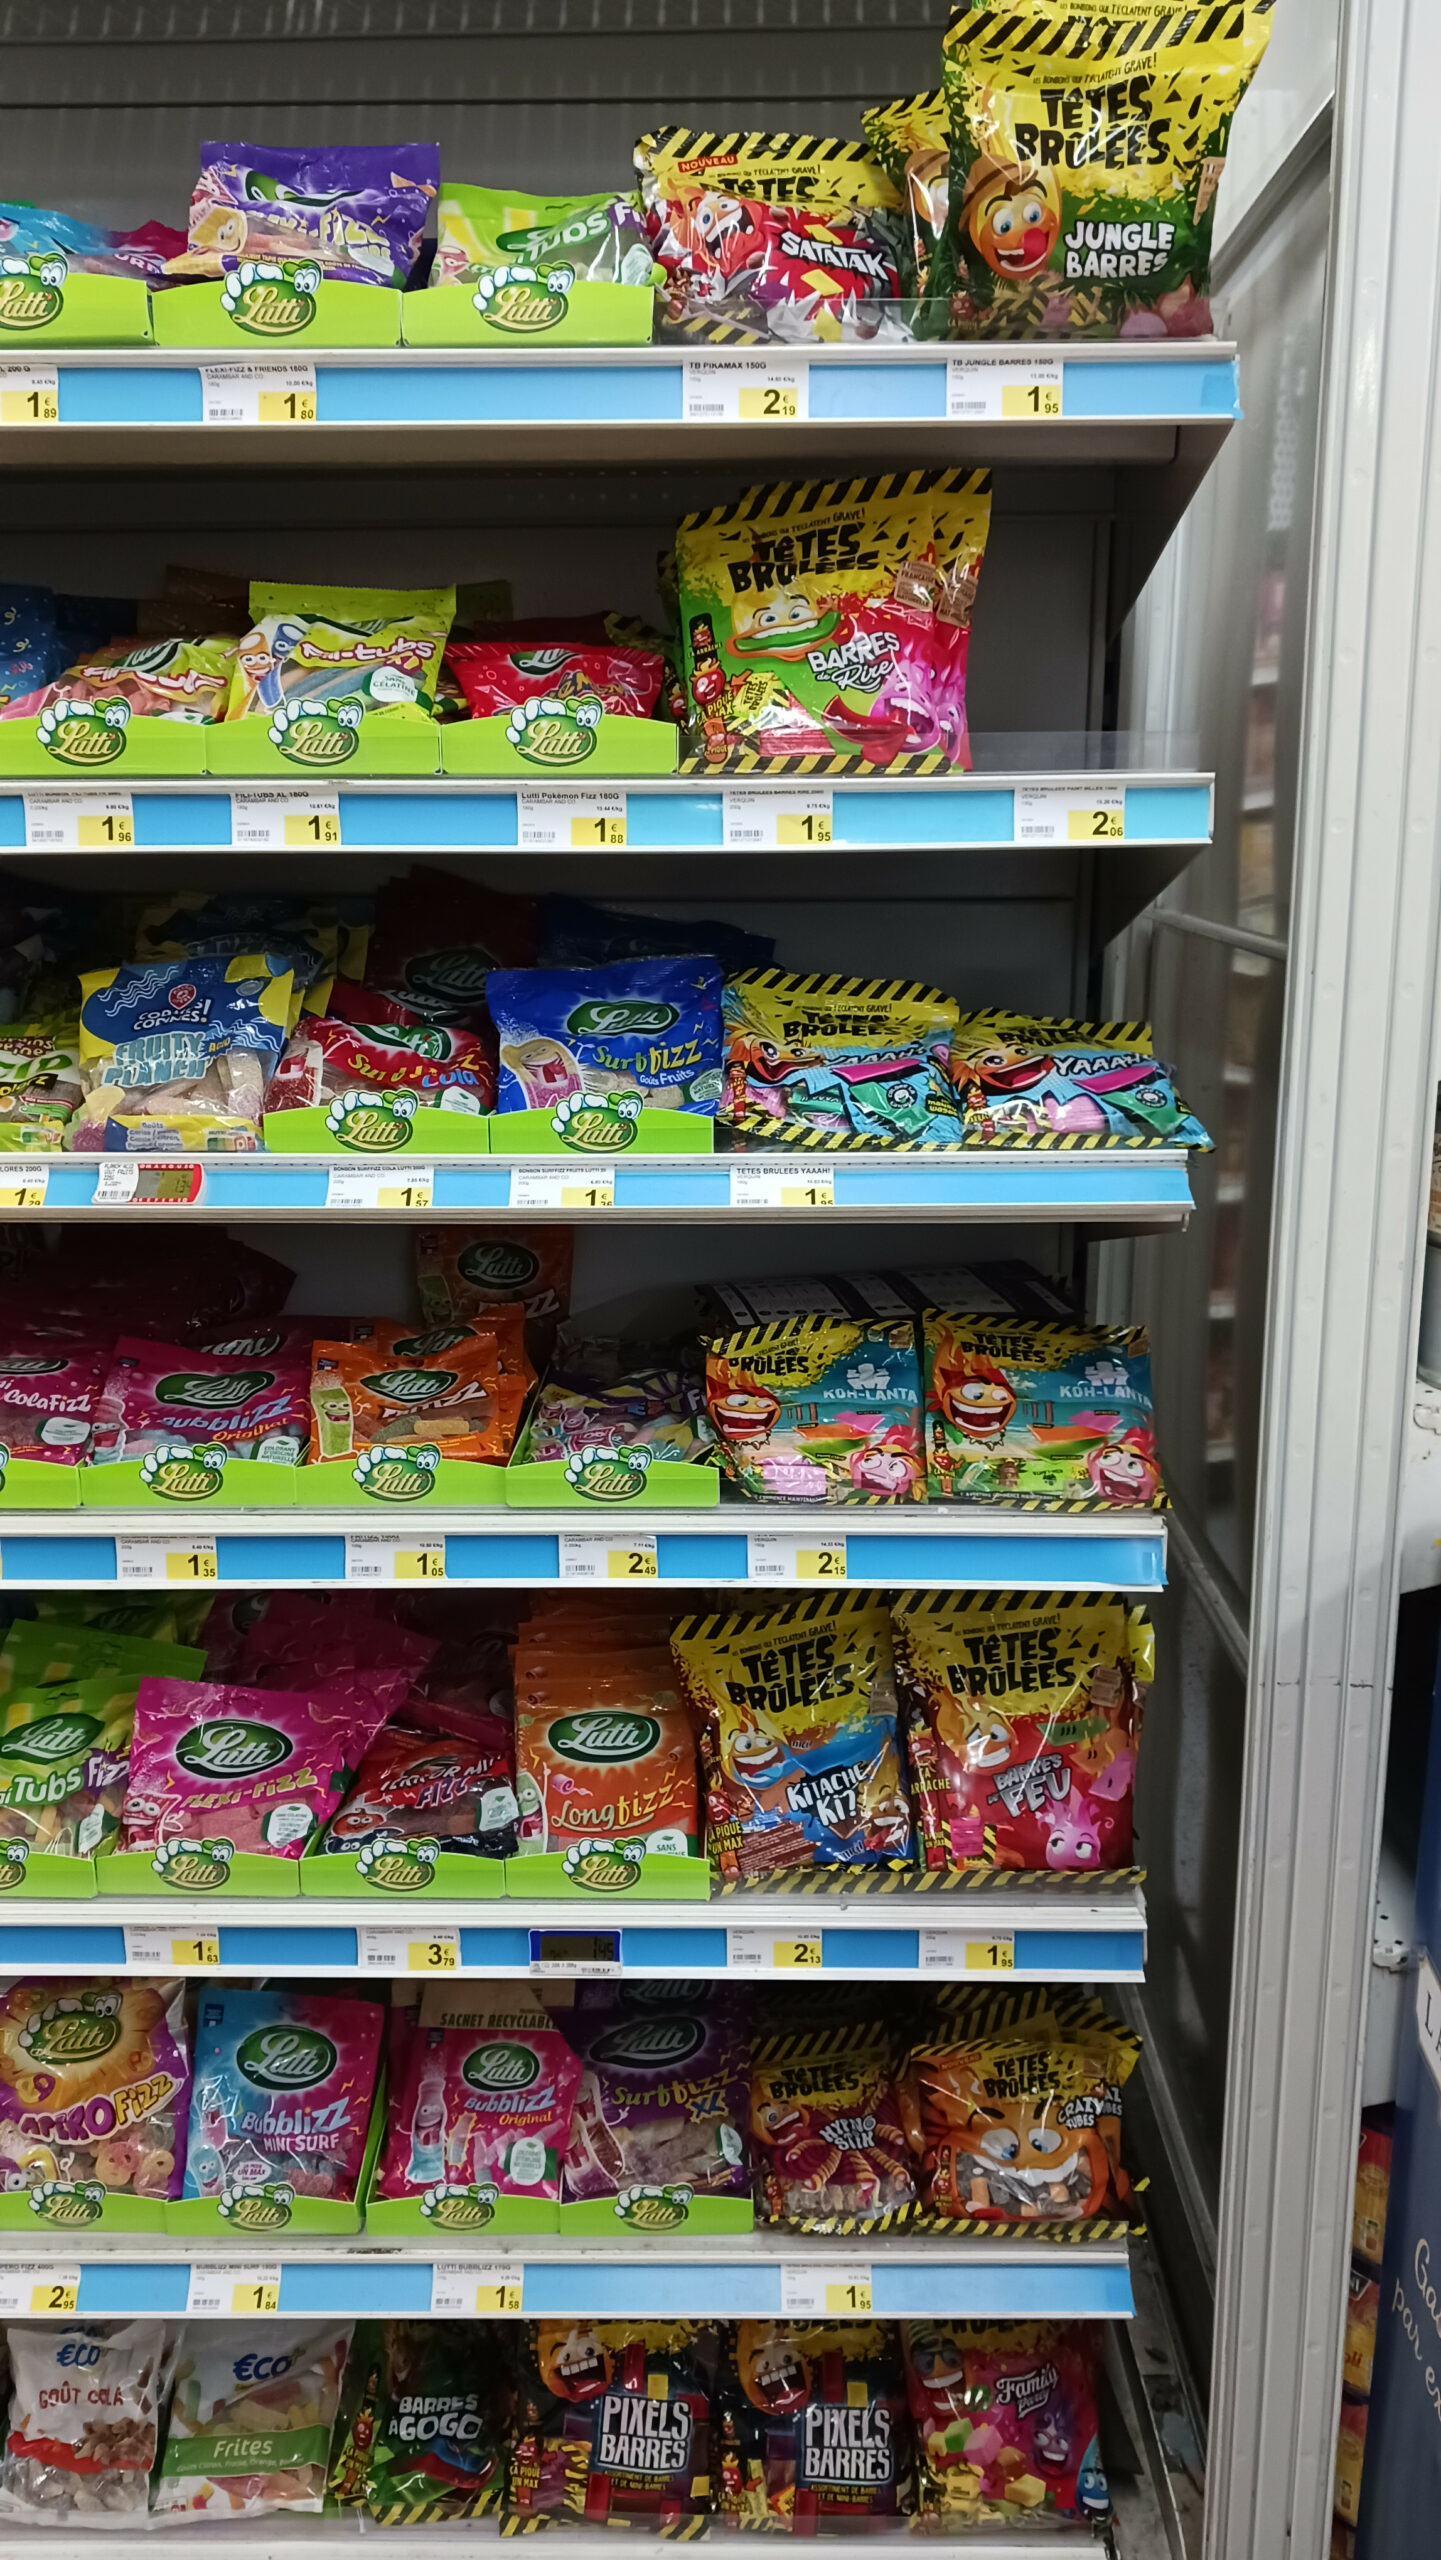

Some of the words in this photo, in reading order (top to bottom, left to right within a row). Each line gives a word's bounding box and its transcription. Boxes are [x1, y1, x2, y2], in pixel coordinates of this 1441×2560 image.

[681, 155, 735, 172] NOUVEAU
[1065, 221, 1175, 250] JUNGLE
[781, 231, 889, 280] SATATAK
[1066, 251, 1168, 279] BARRES
[234, 286, 304, 324] Lutti
[484, 287, 557, 324] Lutti
[806, 630, 901, 675] BARRES
[49, 721, 111, 757] Lutti
[281, 721, 345, 757] Lutti
[517, 720, 583, 757] Lutti
[521, 792, 539, 800] Lutti
[542, 791, 579, 800] Pokémon
[581, 792, 597, 800] Fizz
[115, 1032, 206, 1066] FRUITY
[659, 1068, 694, 1086] Fruits
[336, 1110, 401, 1144] Lutti
[561, 1110, 624, 1144] Lutti
[737, 1167, 761, 1175] TETES
[763, 1167, 798, 1175] BRULEES
[800, 1167, 831, 1175] YAAAH!
[823, 1388, 918, 1403] KOH-LANTA
[1060, 1385, 1153, 1408] KOH-LANTA
[151, 1463, 213, 1497] Lutti
[364, 1463, 424, 1494] Lutti
[575, 1463, 636, 1494] Lutti
[741, 1634, 837, 1684] TÊTES
[963, 1627, 1061, 1665] TÊTES
[2, 1718, 87, 1754] Lutti
[558, 1713, 642, 1752] Lutti
[184, 1727, 273, 1770] Lutti
[994, 1754, 1063, 1790] BARRES
[1001, 1768, 1071, 1817] FEU
[716, 1822, 741, 1839] PIQUE
[724, 1838, 743, 1852] MAX
[160, 1855, 218, 1884] Lutti
[374, 1856, 424, 1886] Lutti
[580, 1856, 630, 1886] Lutti
[440, 2013, 483, 2027] SACHET
[488, 2012, 556, 2029] RECYCLABL
[31, 2019, 105, 2057] Lutti
[245, 2032, 319, 2077] Lutti
[468, 2046, 526, 2083] Lutti
[499, 2111, 552, 2126] Original
[1058, 2097, 1104, 2123] CRAZY
[295, 2134, 339, 2151] SURF
[819, 2115, 876, 2143] HYPNO
[40, 2199, 92, 2224] Lutti
[229, 2200, 280, 2226] Lutti
[437, 2199, 484, 2226] Lutti
[632, 2199, 678, 2226] Lutti
[39, 2381, 80, 2409] GOÛT
[88, 2386, 125, 2407] COLA
[996, 2363, 1059, 2404] Family
[399, 2394, 478, 2415] BARRES
[602, 2395, 689, 2441] PIXELS
[399, 2413, 483, 2441] GOGO
[805, 2407, 891, 2448] PIXELS
[214, 2437, 273, 2458] Frites
[600, 2434, 686, 2469] BARRES
[805, 2446, 891, 2480] BARRES
